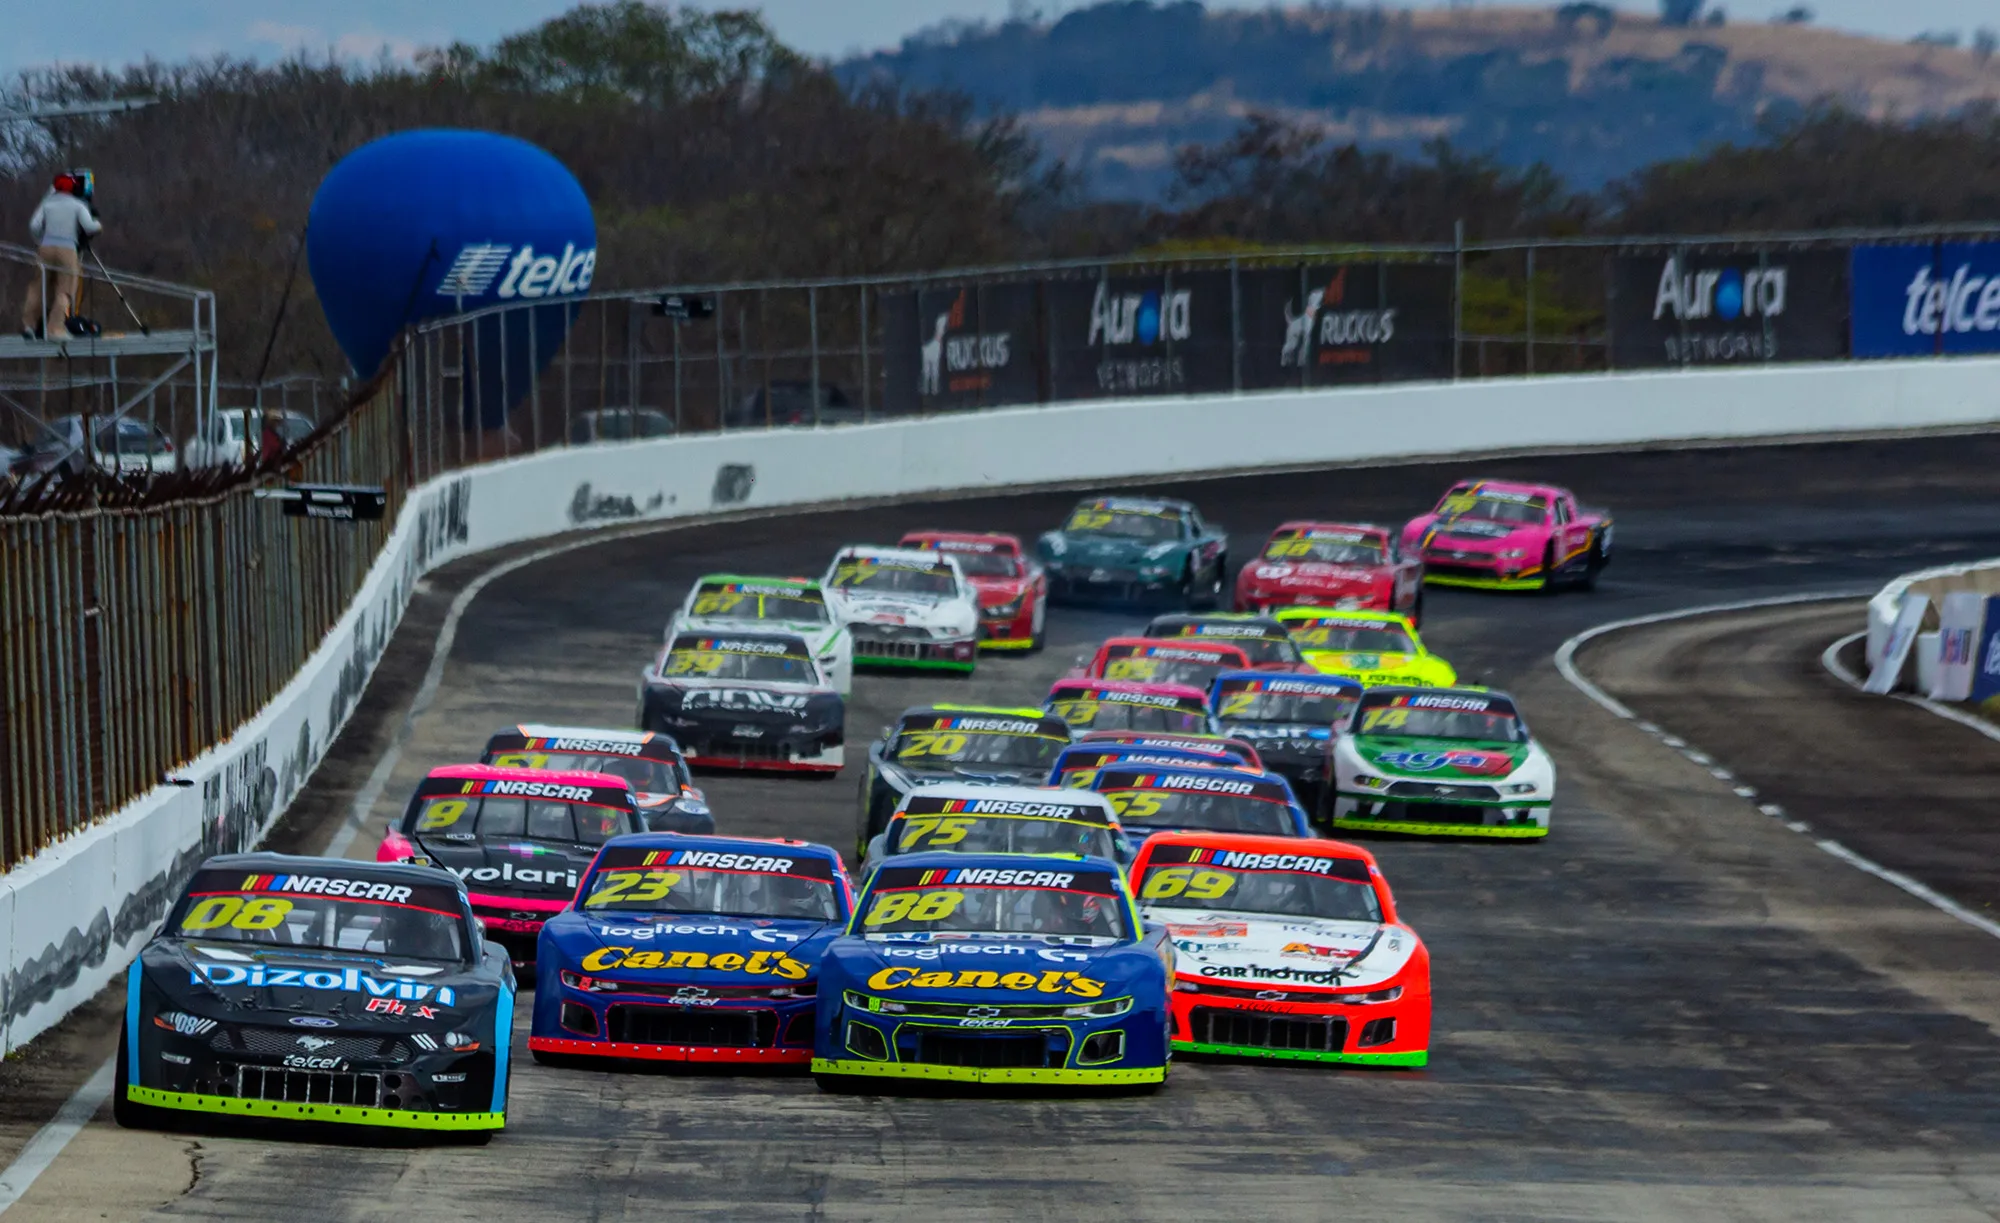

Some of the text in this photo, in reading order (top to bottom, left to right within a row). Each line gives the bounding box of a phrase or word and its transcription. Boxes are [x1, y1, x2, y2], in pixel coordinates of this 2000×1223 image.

[1320, 308, 1395, 345] RUCKUS
[1201, 626, 1266, 637] NASCAR
[719, 640, 788, 655] NASCAR
[1152, 647, 1222, 663] NASCAR
[1268, 680, 1341, 695] NASCAR
[1105, 691, 1180, 708] NASCAR
[1221, 692, 1255, 717] 2
[1414, 695, 1490, 712] NASCAR
[958, 718, 1039, 734] NASCAR
[1362, 708, 1410, 731] 14
[554, 737, 643, 757] NASCAR
[898, 735, 967, 758] 20
[493, 780, 594, 802] NASCAR
[1162, 775, 1255, 795] NASCAR
[421, 800, 468, 829] 9
[972, 798, 1075, 819] NASCAR
[899, 818, 978, 848] 75
[679, 850, 794, 874] NASCAR
[1222, 851, 1334, 875] NASCAR
[445, 862, 580, 889] volari
[955, 867, 1075, 889] NASCAR
[1142, 868, 1237, 900] 69
[282, 873, 412, 904] NASCAR
[584, 871, 682, 906] 23
[181, 897, 294, 931] 08
[863, 891, 965, 927] 88
[601, 923, 739, 940] logitech
[883, 943, 1026, 961] logitech
[581, 946, 813, 981] Canel's
[1200, 965, 1248, 979] CAR
[190, 962, 456, 1008] Dizolvin
[867, 966, 1106, 998] Canel's
[958, 1017, 1014, 1028] telcel
[282, 1054, 342, 1071] telcel
